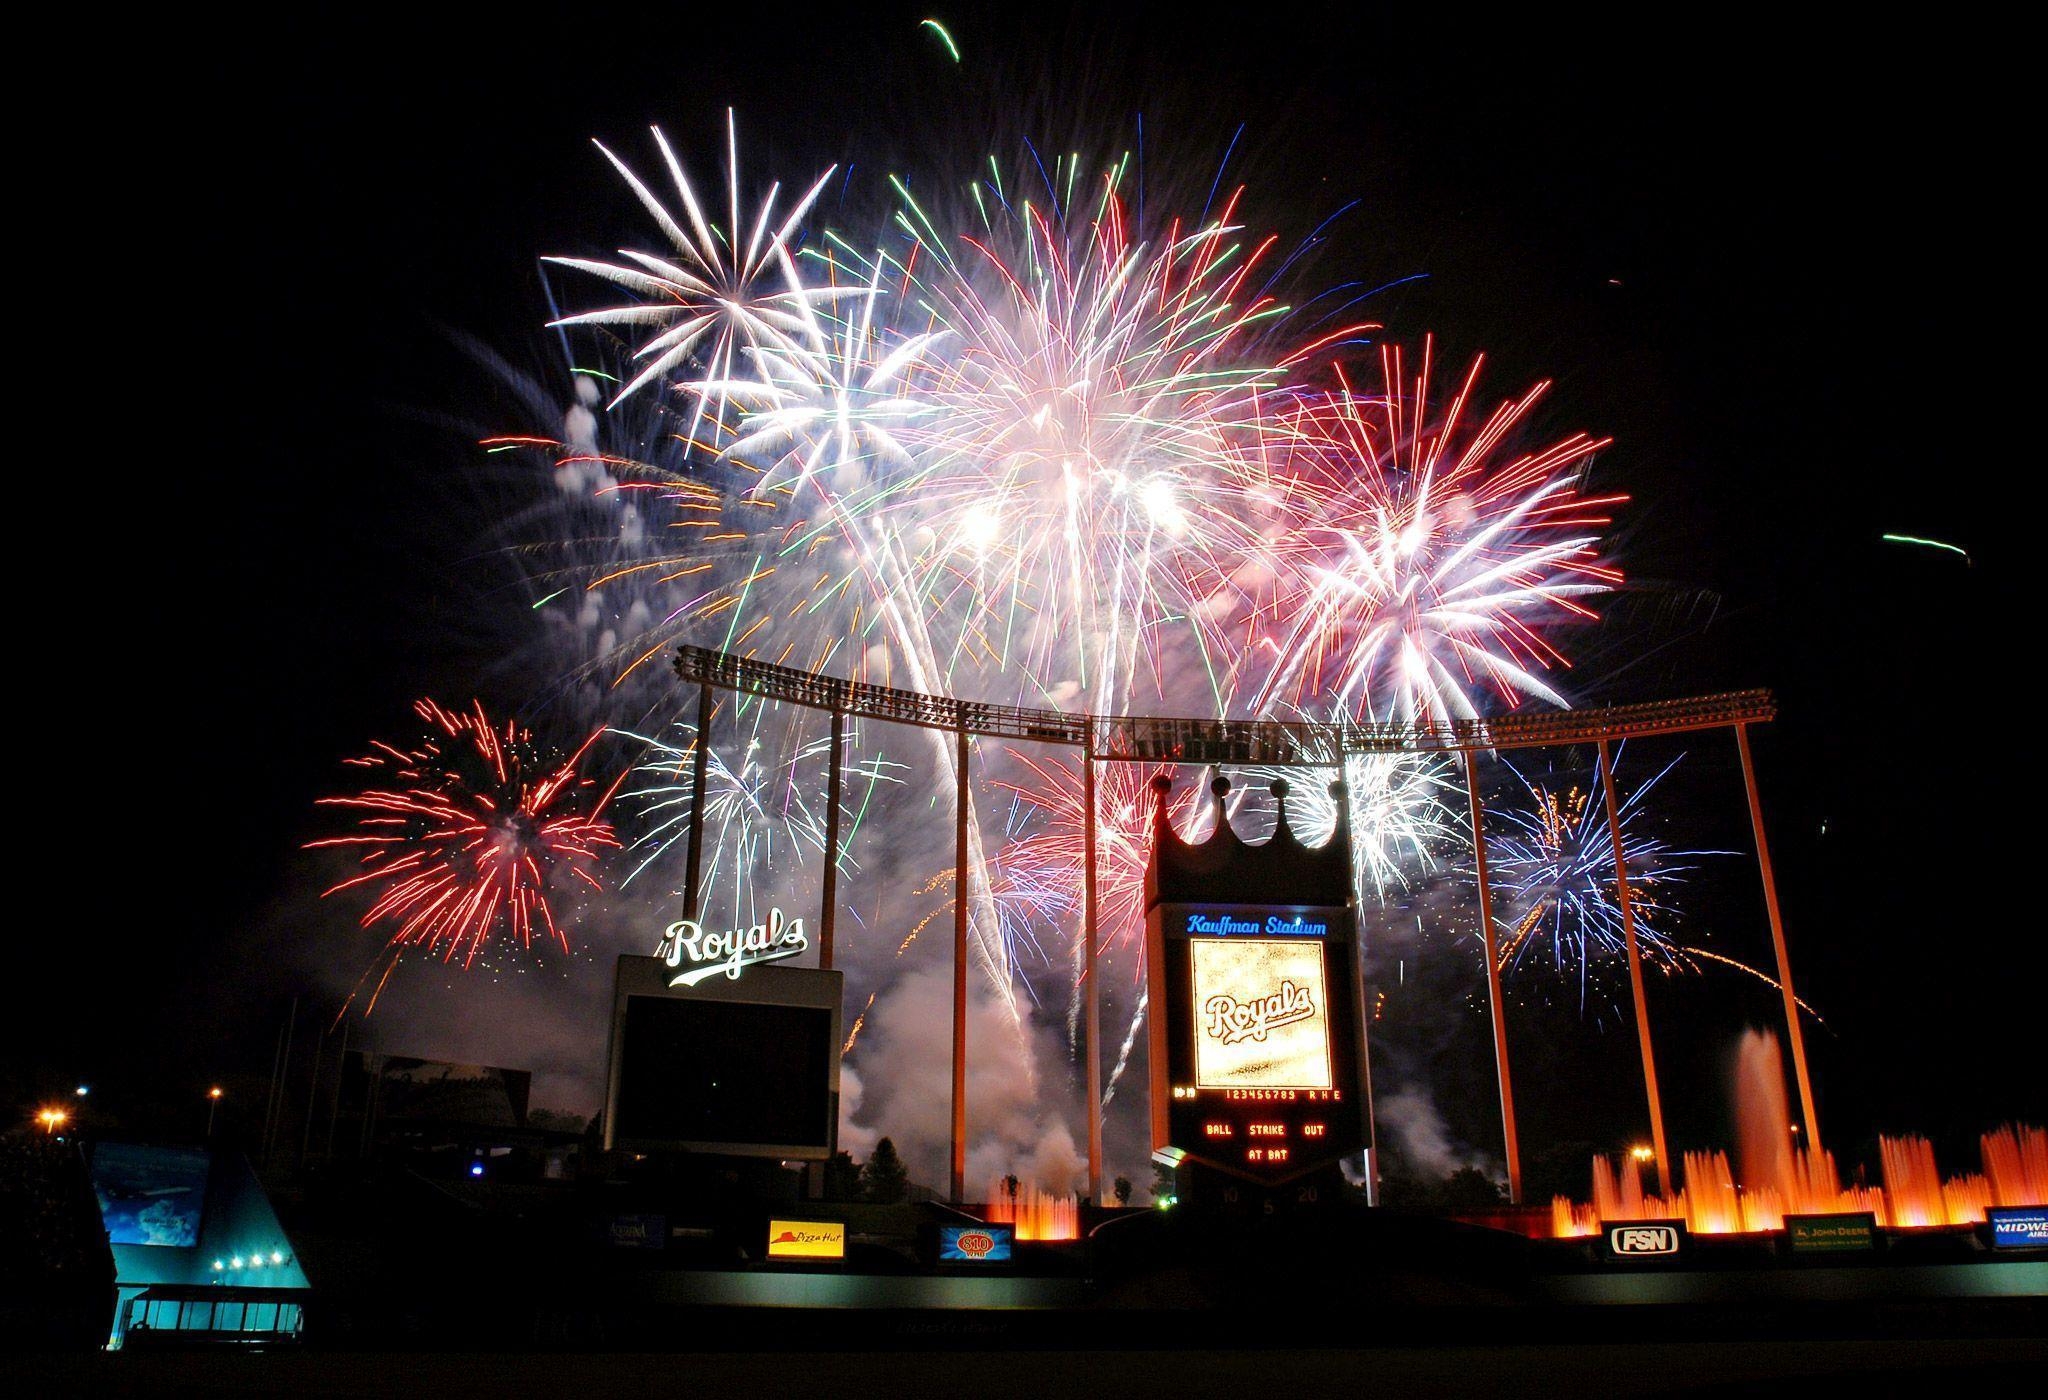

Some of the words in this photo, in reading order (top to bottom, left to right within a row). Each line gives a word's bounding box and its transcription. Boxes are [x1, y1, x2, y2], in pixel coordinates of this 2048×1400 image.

[1186, 914, 1260, 936] Kauffman
[1265, 915, 1327, 935] Stadium
[665, 907, 808, 987] Royals
[1206, 980, 1315, 1045] Royals
[1206, 1124, 1232, 1136] BALL
[1249, 1124, 1286, 1136] STRIKE
[1304, 1125, 1325, 1136] OUT
[1248, 1149, 1263, 1161] AT
[1267, 1149, 1289, 1161] BAT
[796, 1232, 821, 1243] Pizza
[822, 1232, 841, 1242] Hut
[1812, 1228, 1837, 1237] JOHN
[962, 1236, 989, 1251] 810
[1623, 1230, 1666, 1251] FSN
